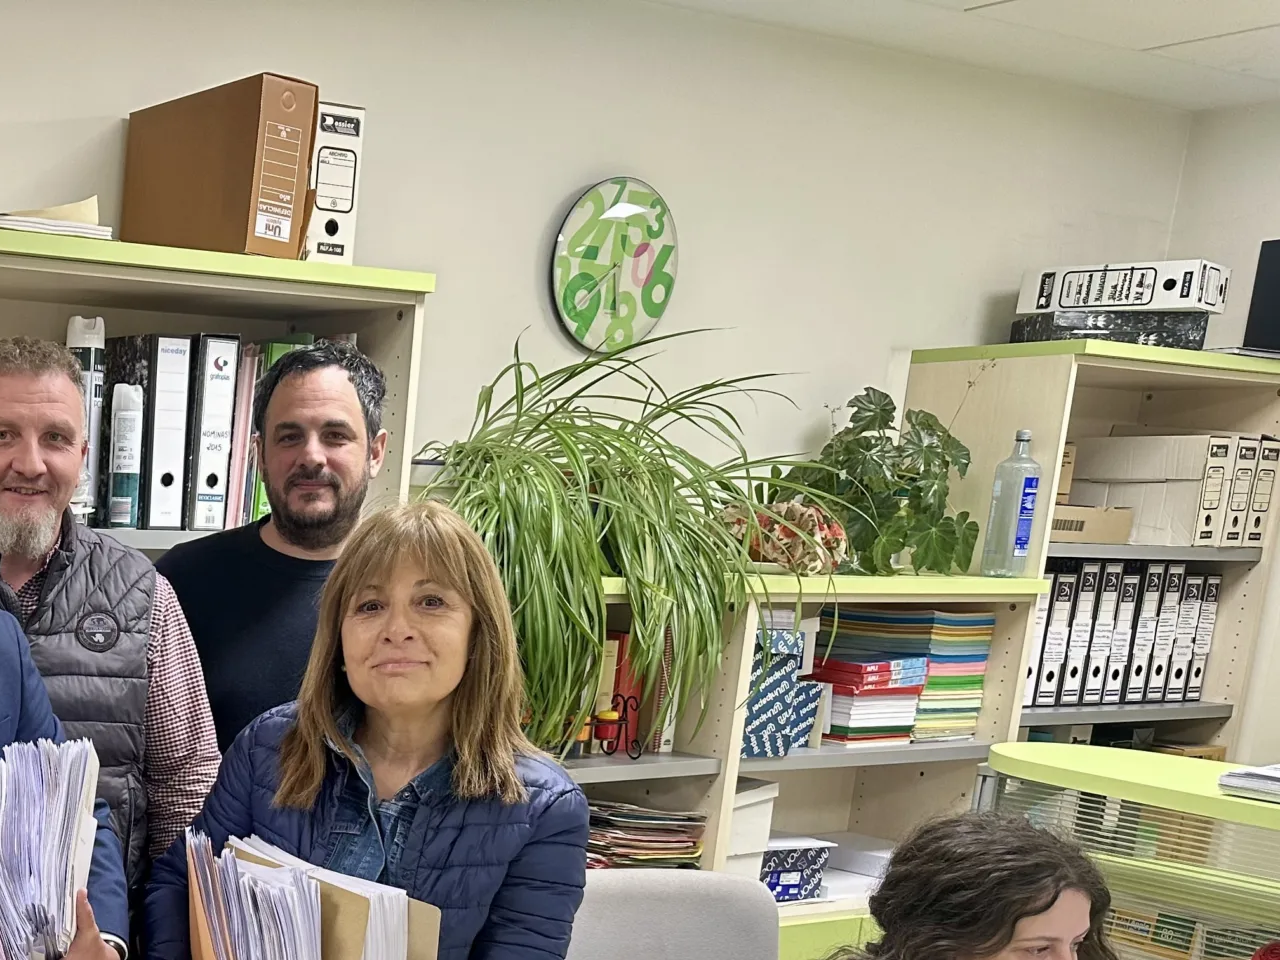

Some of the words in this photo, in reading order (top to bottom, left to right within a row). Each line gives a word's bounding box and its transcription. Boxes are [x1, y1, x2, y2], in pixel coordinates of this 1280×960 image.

[646, 197, 666, 239] 3
[563, 272, 601, 341] 9
[641, 244, 675, 318] 6
[160, 346, 187, 356] niceday
